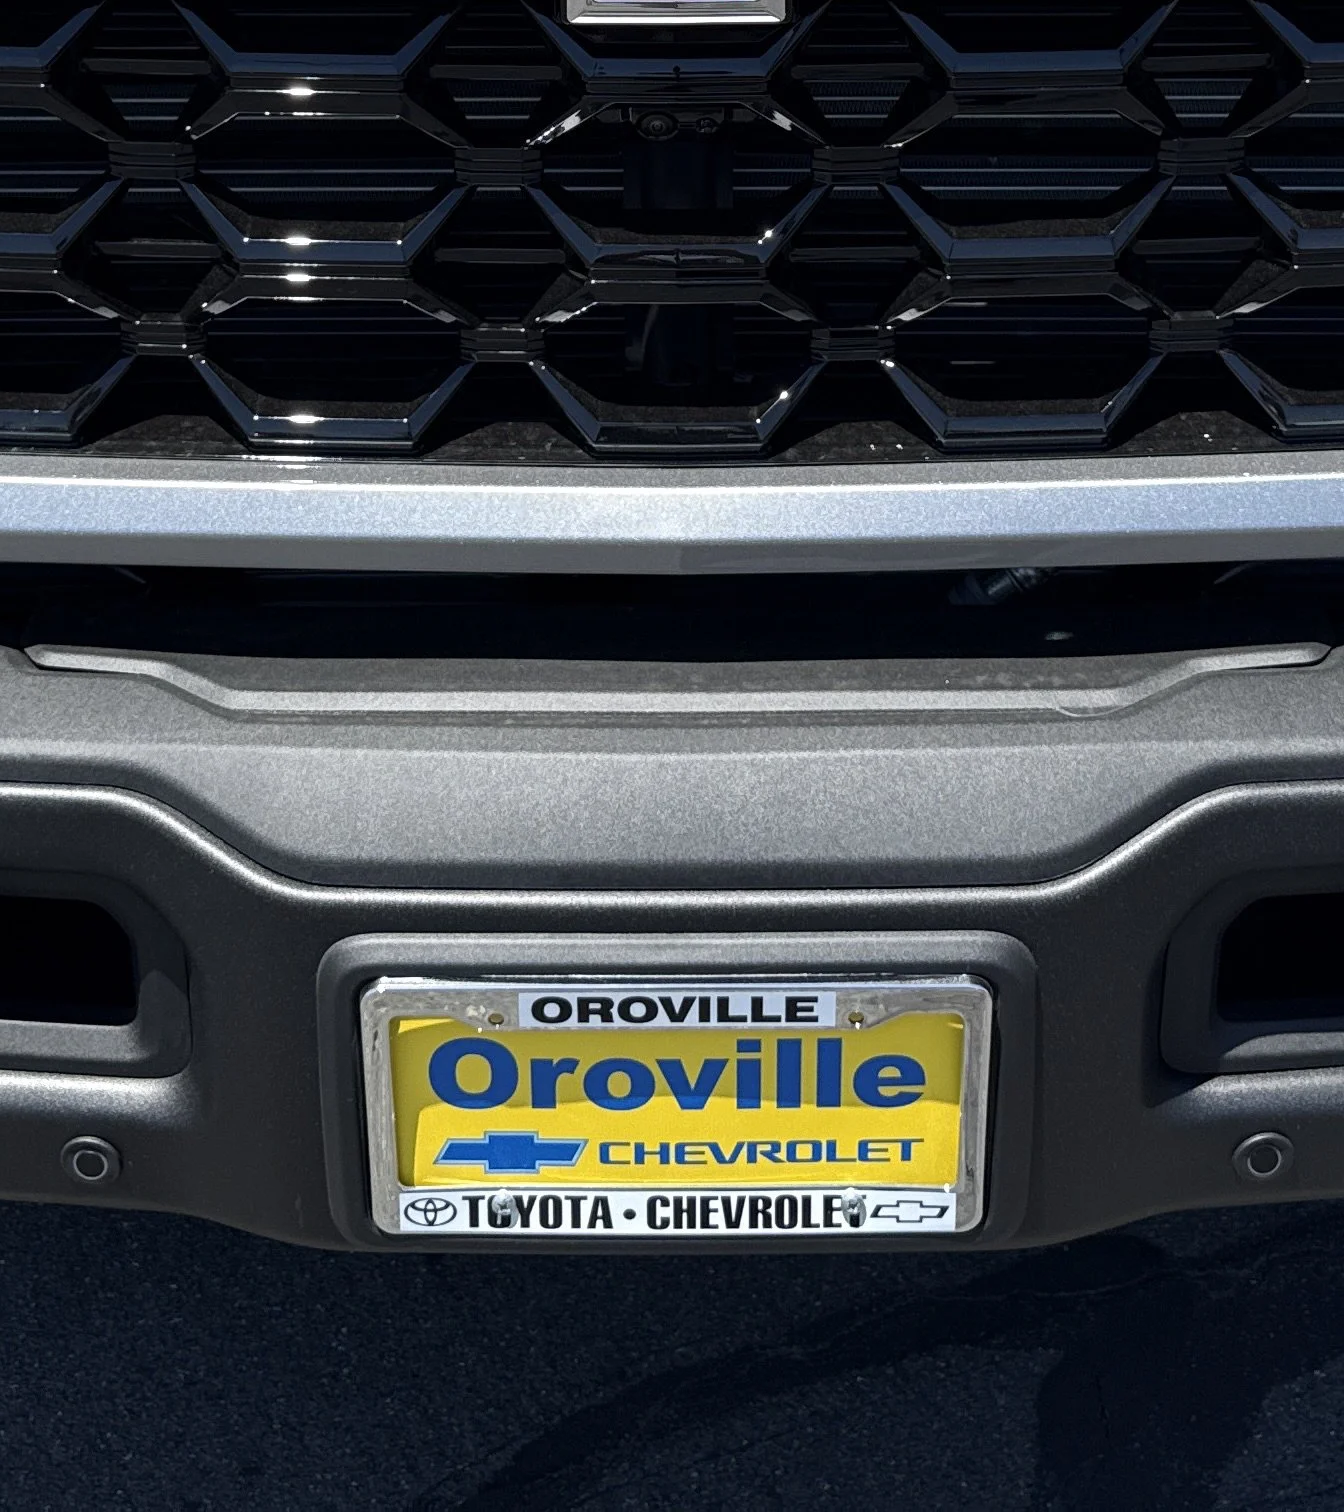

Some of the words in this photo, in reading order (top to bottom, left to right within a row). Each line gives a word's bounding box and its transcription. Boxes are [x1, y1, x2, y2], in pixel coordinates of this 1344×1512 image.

[531, 996, 819, 1023] OROVILLE
[428, 1038, 926, 1111] Oroville
[599, 1138, 924, 1164] CHEVROLET
